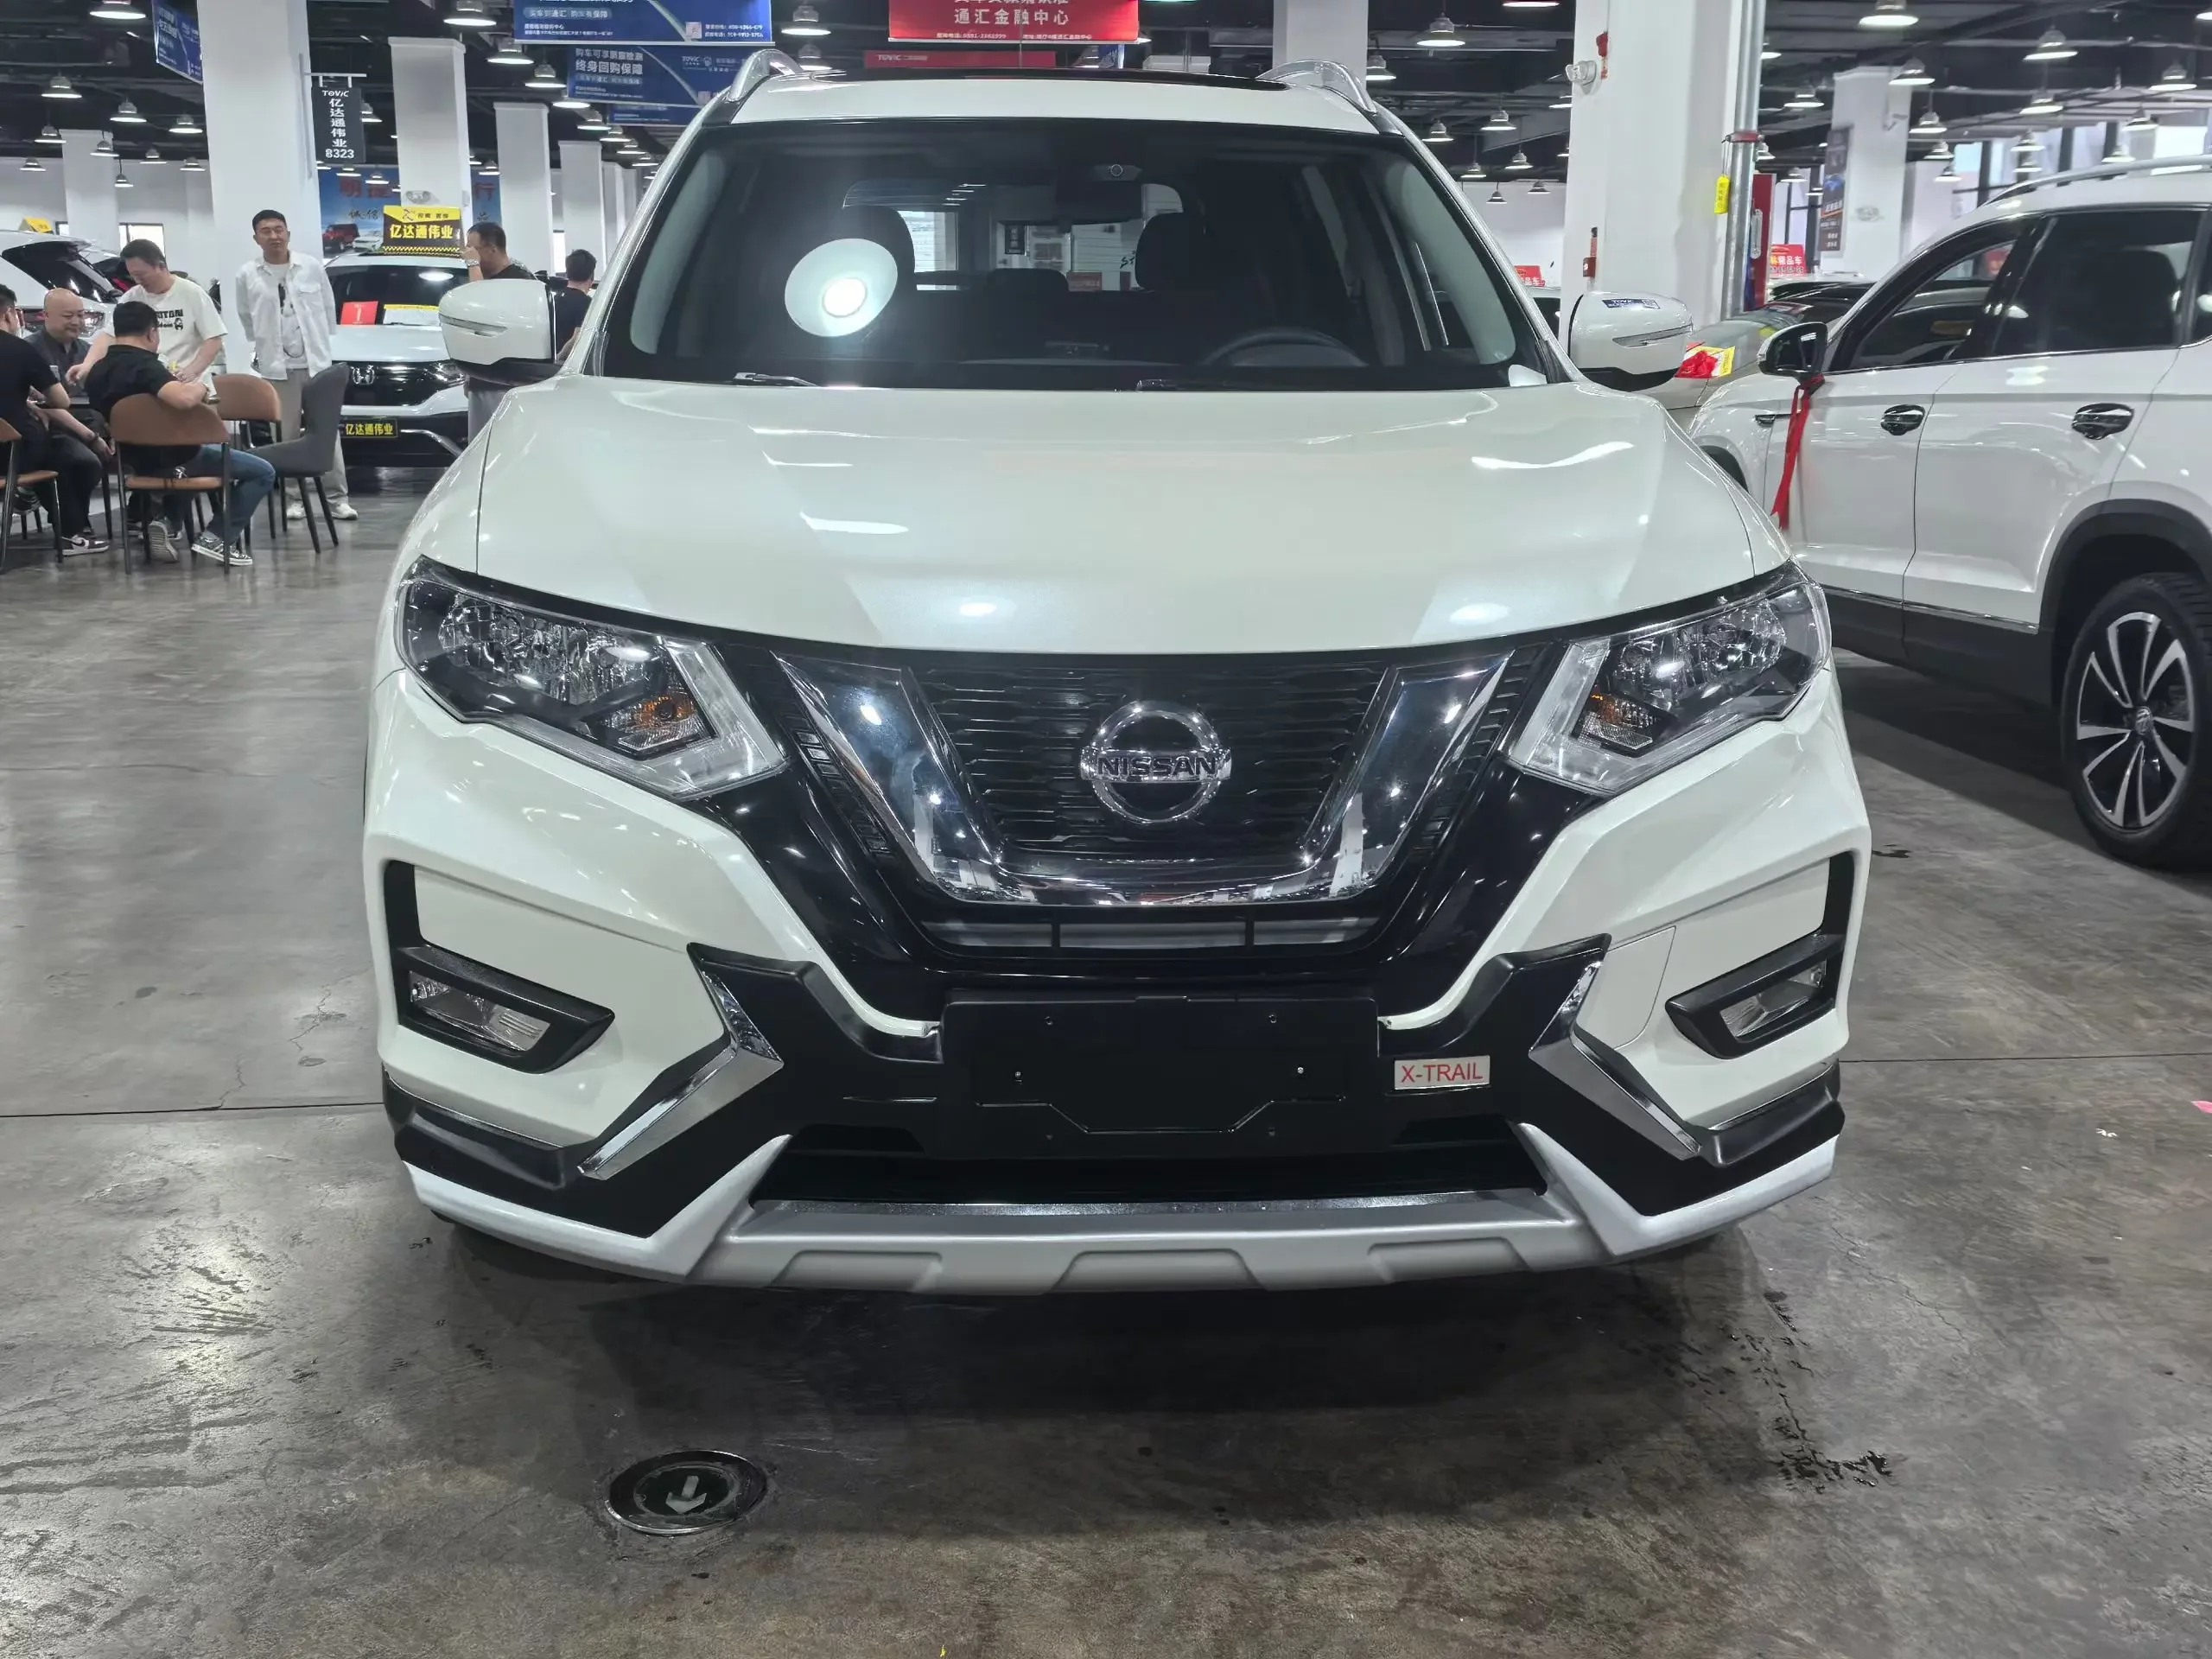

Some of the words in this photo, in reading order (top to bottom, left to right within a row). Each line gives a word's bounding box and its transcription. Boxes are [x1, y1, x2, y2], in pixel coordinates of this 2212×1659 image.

[954, 8, 1069, 26] 通汇金融中心
[575, 60, 643, 75] 终身回购保障
[329, 98, 347, 148] 亿达通伟业
[325, 149, 354, 158] 8323
[390, 224, 454, 238] 亿达通伟业
[346, 423, 393, 435] 亿达通伟业
[1097, 755, 1217, 777] NISSAN
[1402, 1062, 1484, 1083] X-TRAIL
